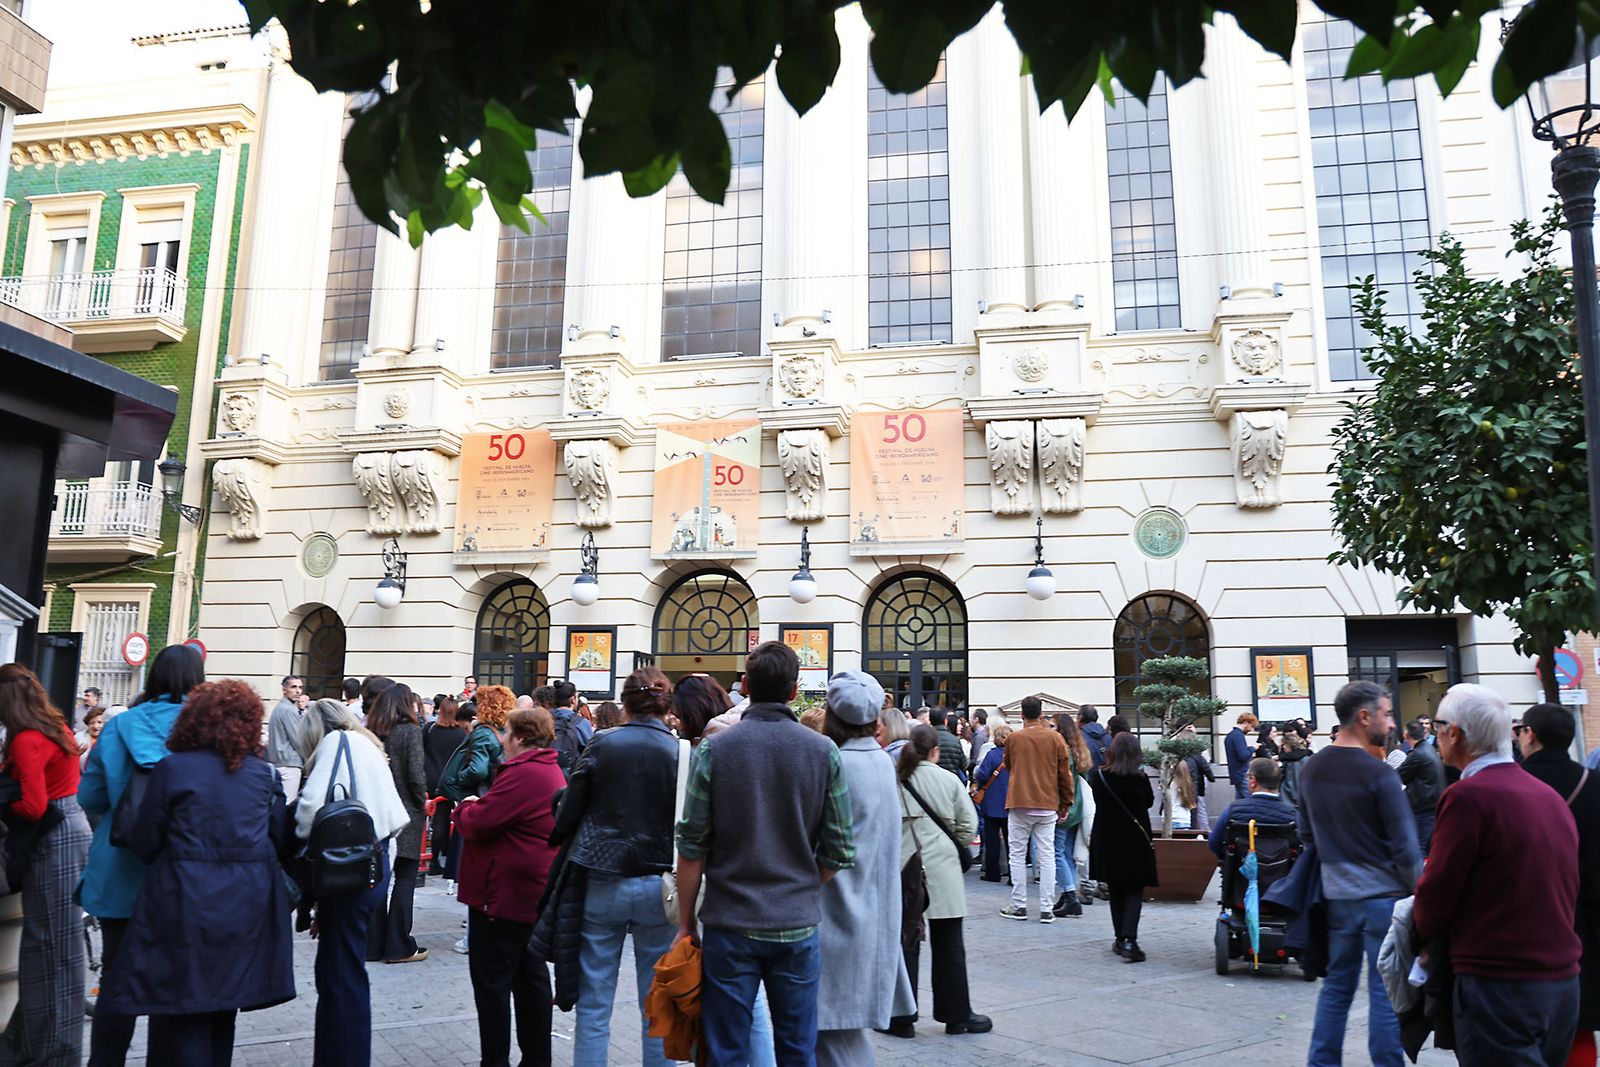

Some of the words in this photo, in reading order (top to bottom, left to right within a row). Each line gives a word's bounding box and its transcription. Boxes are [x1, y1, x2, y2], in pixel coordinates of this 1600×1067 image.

[883, 414, 926, 443] 50
[488, 434, 525, 461] 50
[714, 465, 744, 486] 50
[574, 635, 584, 645] 19
[596, 635, 607, 644] 50
[788, 633, 798, 643] 17
[1260, 659, 1273, 669] 18
[1288, 658, 1300, 668] 50
